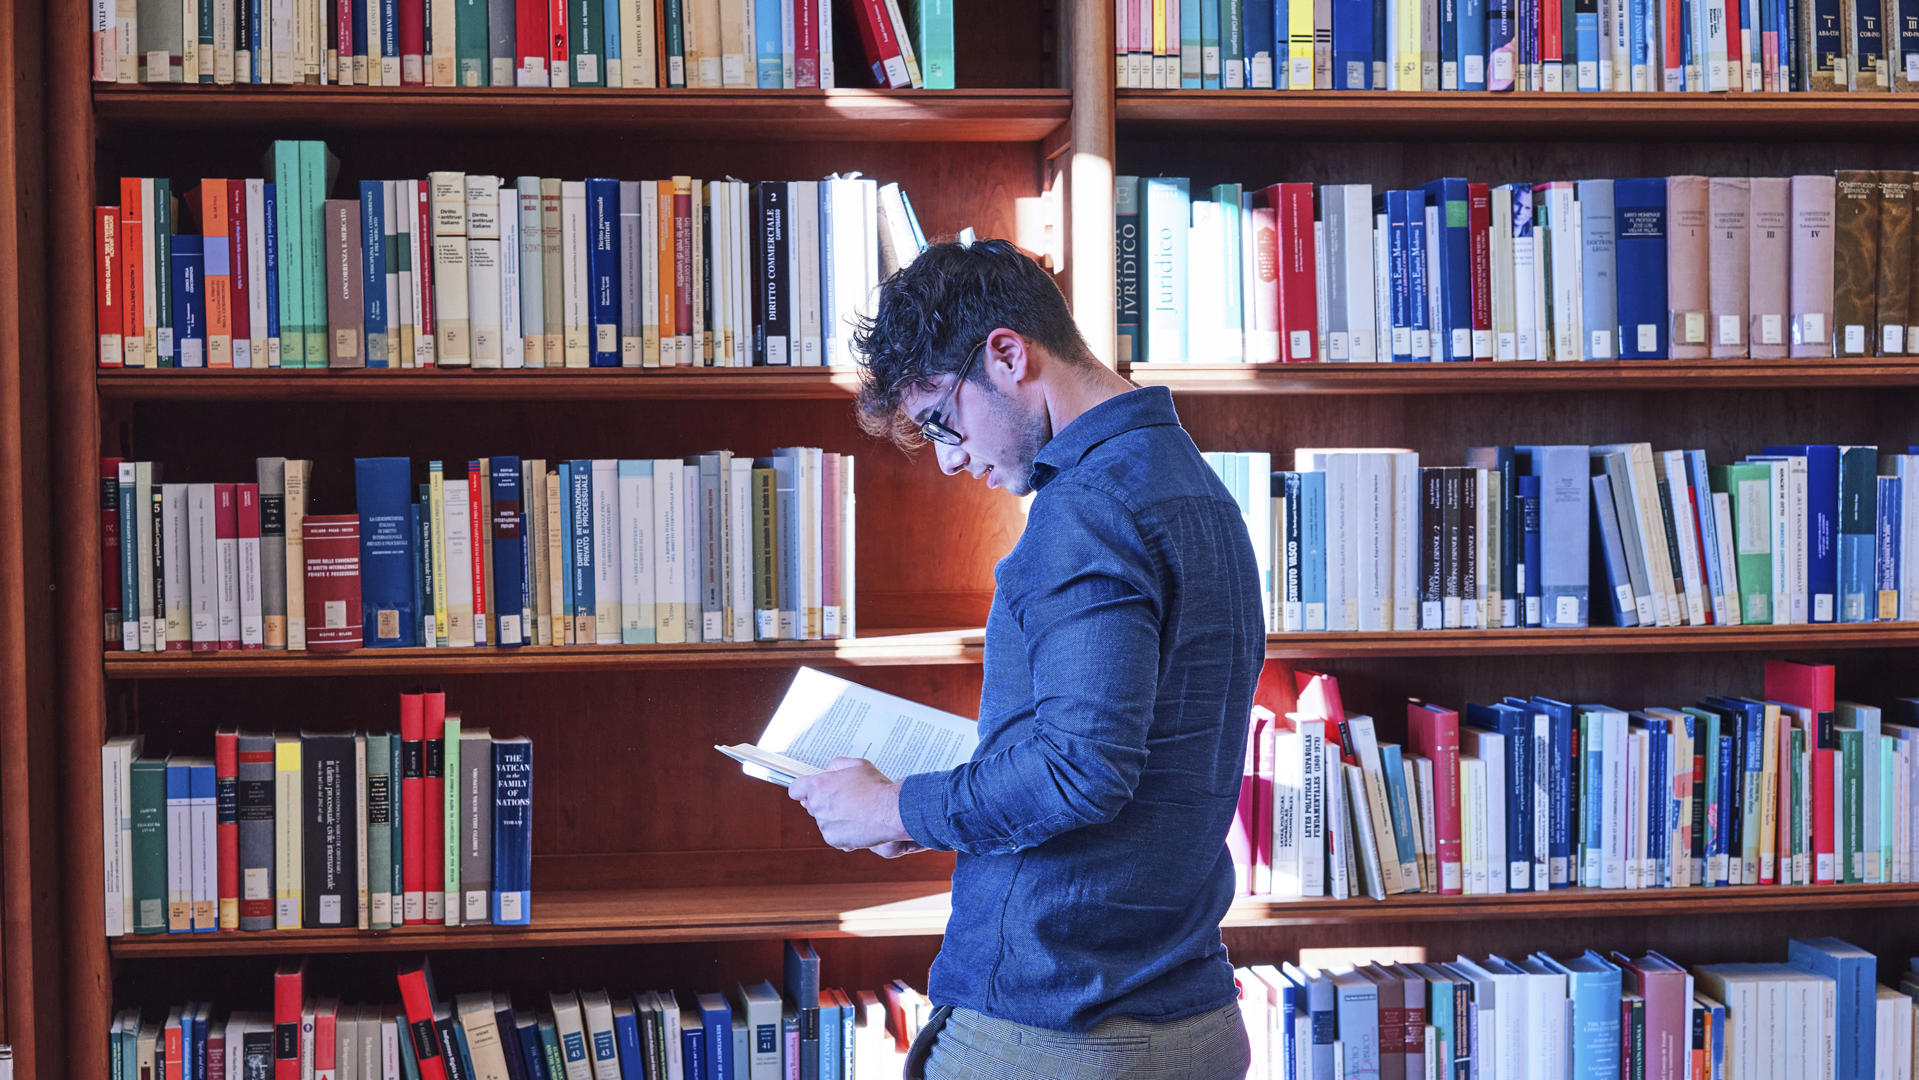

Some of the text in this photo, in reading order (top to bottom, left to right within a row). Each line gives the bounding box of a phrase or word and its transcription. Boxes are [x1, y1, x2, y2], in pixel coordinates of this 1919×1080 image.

[340, 208, 348, 242] MERCATO
[1810, 230, 1821, 238] IV
[342, 248, 350, 299] CONCORRENZA
[766, 208, 777, 321] DIRITTO COMMERCIALE
[574, 474, 583, 536] INTERNAZIONALE
[581, 474, 590, 527] PROCESSUALE
[576, 538, 584, 567] DIRITTO
[1288, 540, 1298, 602] STATUTO VASCO
[496, 763, 530, 772] VATICAN
[504, 754, 522, 763] THE
[1304, 734, 1312, 774] ESPAÑOLAS
[326, 766, 335, 786] diritto
[498, 779, 528, 788] FAMILY
[324, 786, 335, 825] processuale
[496, 798, 530, 807] NATIONS
[507, 789, 519, 797] OF
[327, 826, 335, 843] civile
[327, 844, 336, 890] internazionale
[823, 1024, 831, 1057] COMPANY
